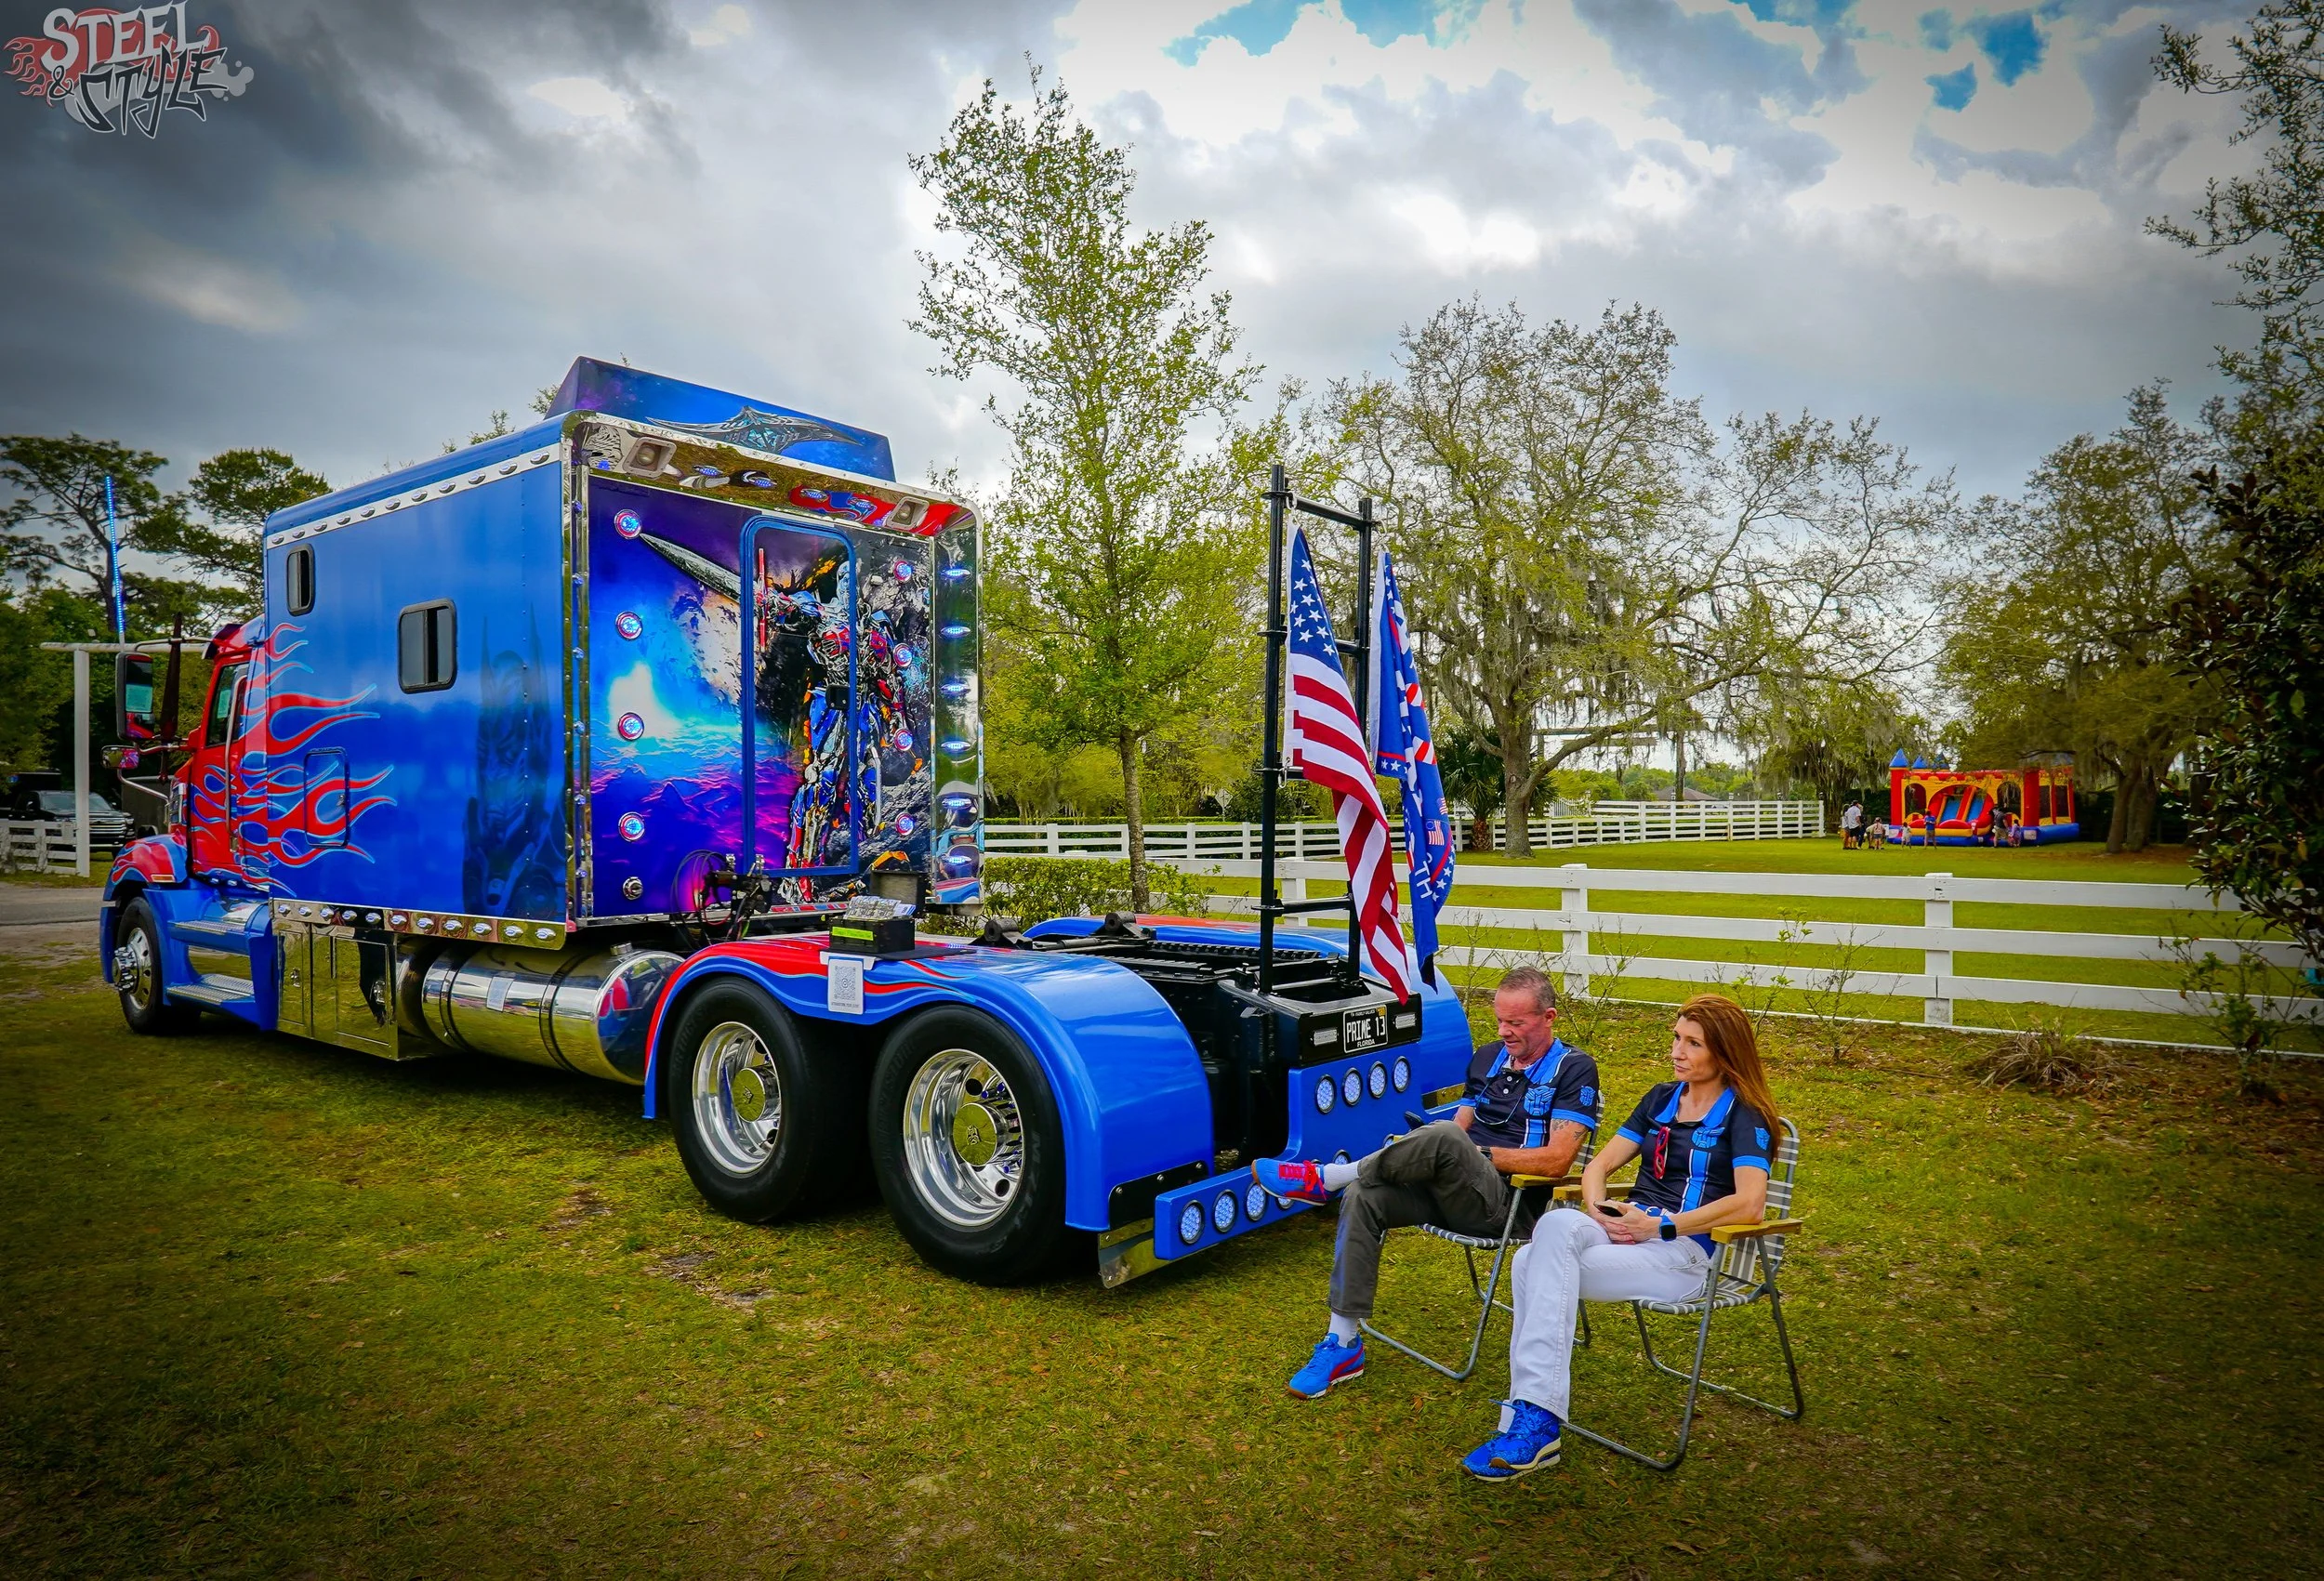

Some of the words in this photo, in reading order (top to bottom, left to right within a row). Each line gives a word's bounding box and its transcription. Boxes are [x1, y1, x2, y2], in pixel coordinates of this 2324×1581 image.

[1346, 1019, 1371, 1043] PRIME
[1376, 1016, 1385, 1036] 13
[1357, 1039, 1375, 1047] FLORIDA
